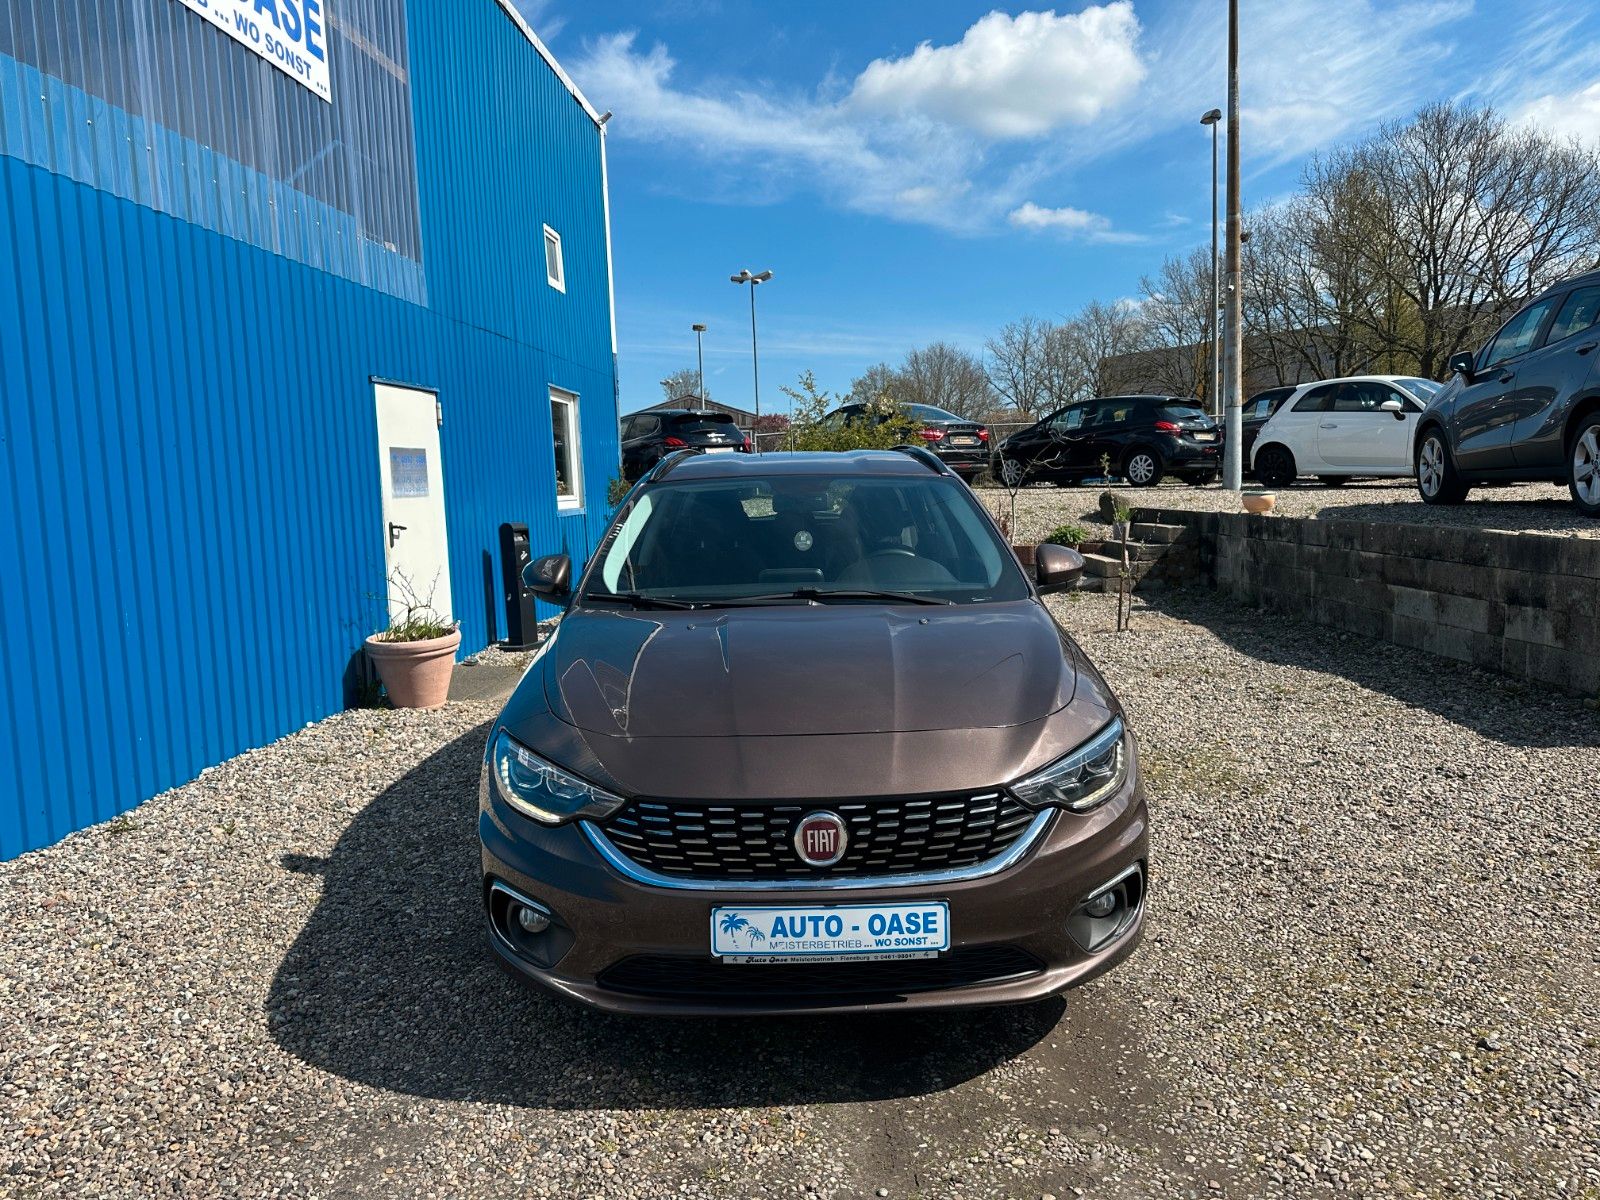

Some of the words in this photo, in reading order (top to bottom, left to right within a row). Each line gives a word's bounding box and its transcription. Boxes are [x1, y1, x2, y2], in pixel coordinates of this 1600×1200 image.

[233, 9, 260, 44] WO
[265, 33, 312, 80] SONST
[806, 829, 837, 853] FIAT
[770, 915, 843, 938] AUTO
[868, 912, 938, 936] OASE
[875, 938, 892, 947] WO
[894, 937, 928, 946] SONST
[745, 956, 767, 964] Auto
[769, 956, 788, 964] Oase
